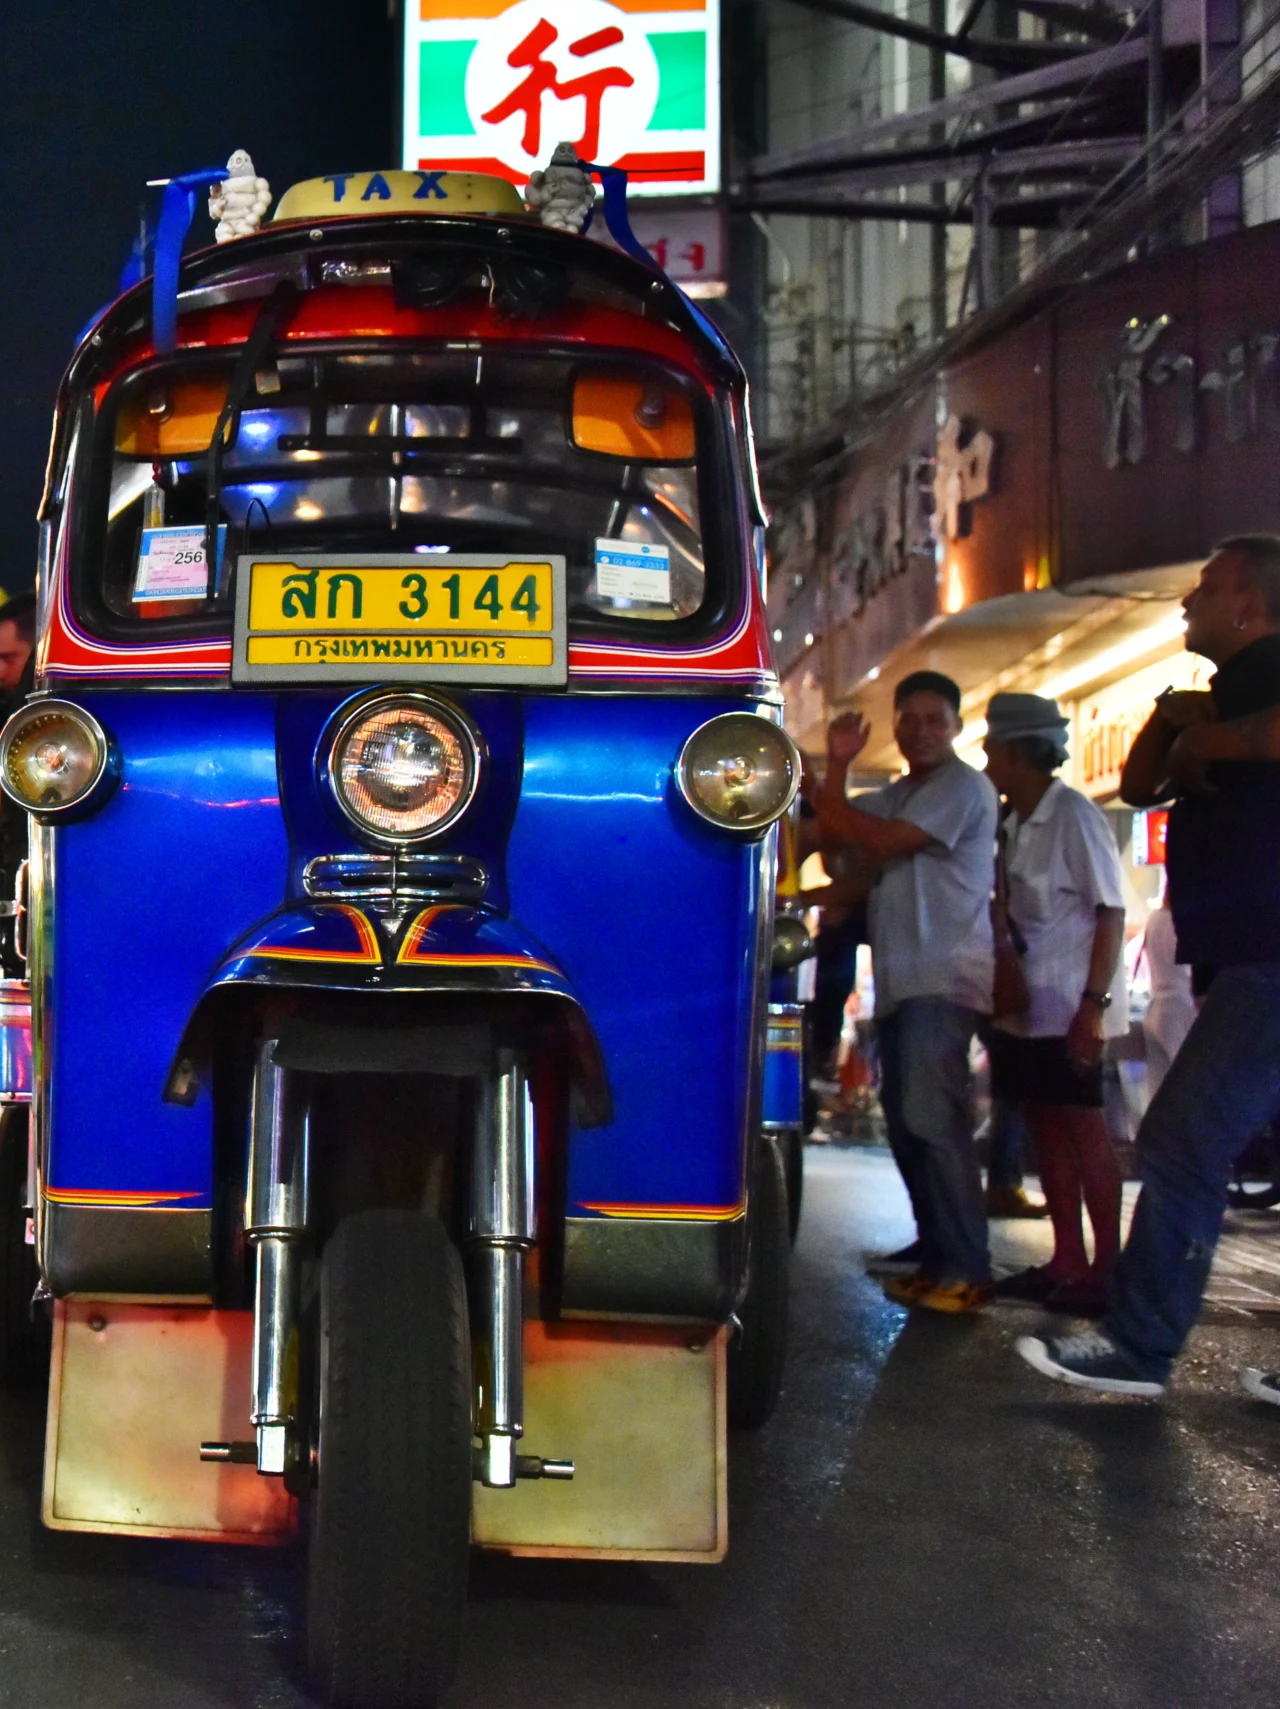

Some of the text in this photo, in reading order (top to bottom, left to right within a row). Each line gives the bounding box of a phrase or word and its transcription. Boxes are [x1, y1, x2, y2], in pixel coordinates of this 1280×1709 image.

[481, 17, 634, 163] 行
[282, 570, 363, 620] สก
[399, 573, 541, 624] 3144
[294, 638, 506, 664] กรุงเทพมหานคร
